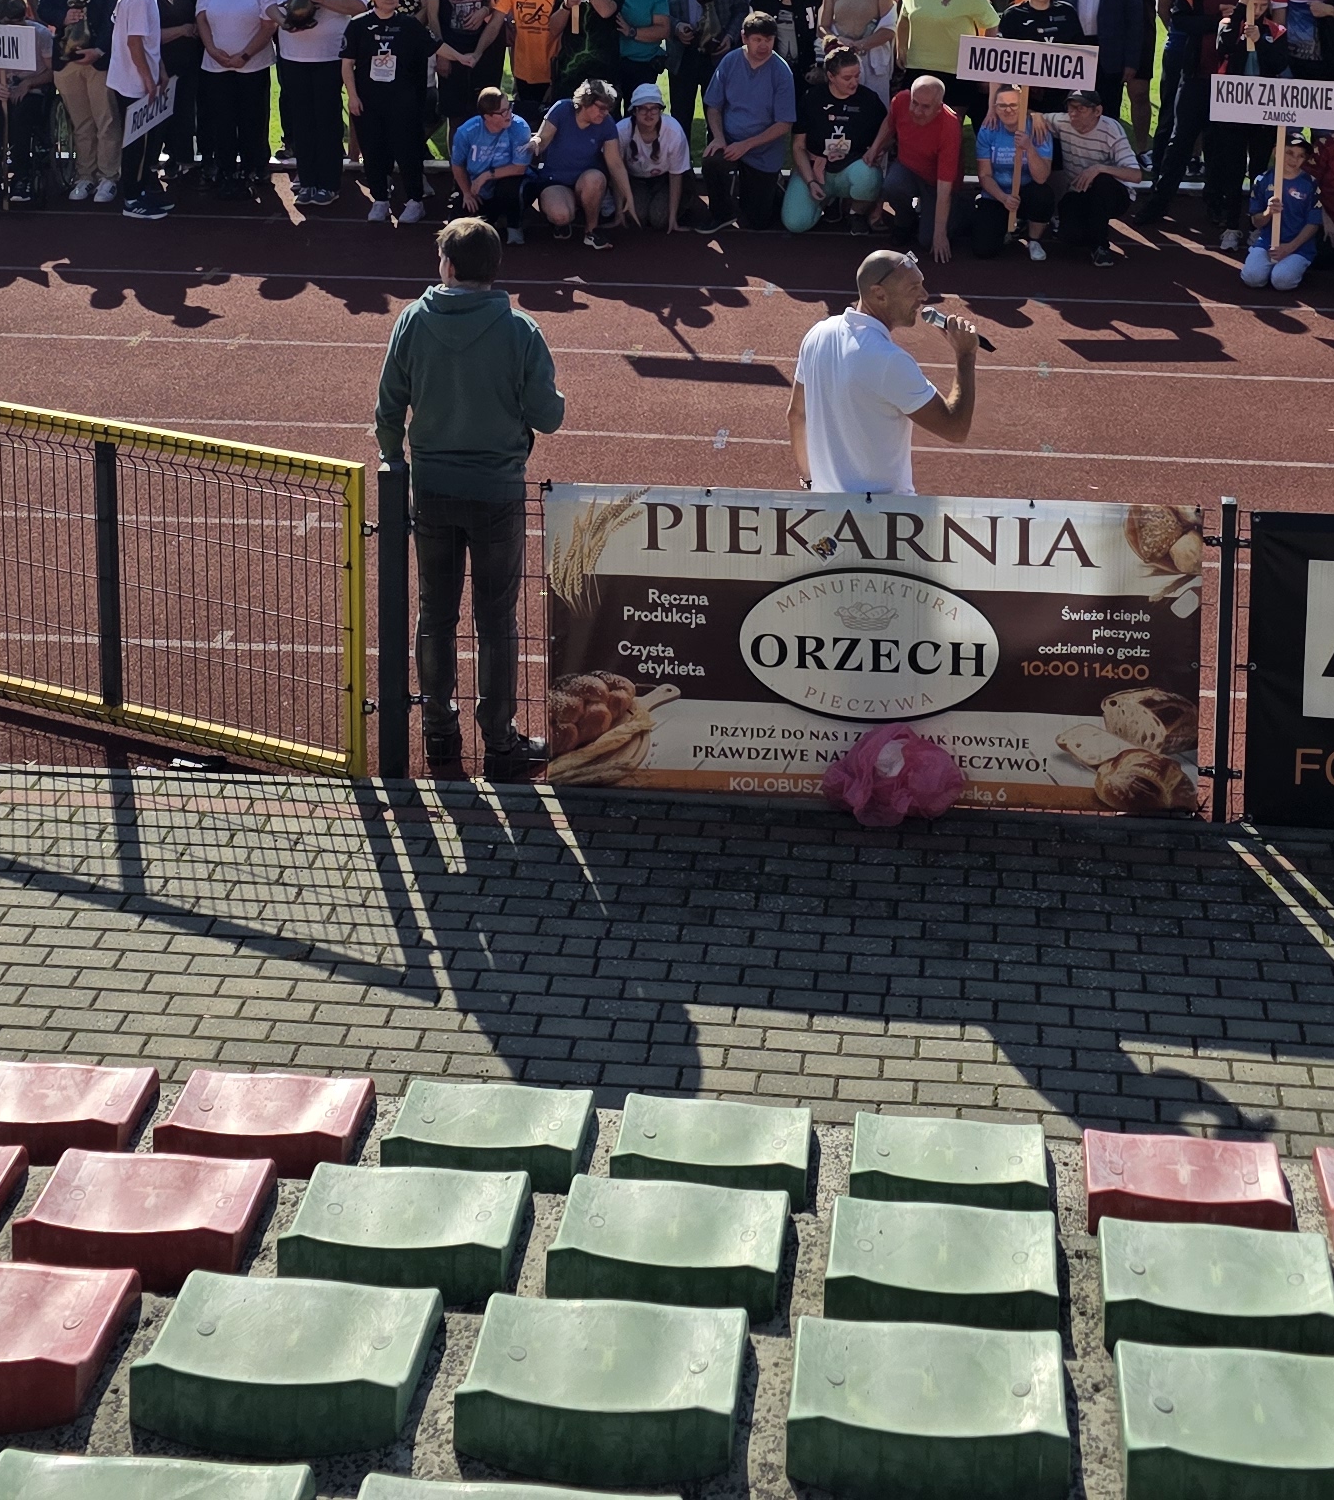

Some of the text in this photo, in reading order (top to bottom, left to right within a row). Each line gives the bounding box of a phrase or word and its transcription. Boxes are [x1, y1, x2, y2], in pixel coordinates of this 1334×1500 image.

[968, 47, 1085, 80] MOGIELNICA
[1215, 82, 1251, 106] KROK
[1257, 84, 1275, 108] ZA
[1262, 109, 1297, 124] ZAMOŚĆ
[641, 502, 1100, 569] PIEKARNIA
[648, 588, 709, 608] Ręczna
[776, 578, 960, 622] MANUFAKTURA
[623, 607, 707, 626] Produkcja
[1061, 607, 1101, 623] Świeże
[1112, 609, 1151, 626] ciepłe
[1092, 627, 1151, 643] pieczywo
[617, 641, 674, 661] Czysta
[750, 633, 987, 677] ORZECH
[1038, 643, 1102, 657] codziennie
[638, 659, 706, 677] etykieta
[1020, 660, 1150, 681] 10:00 i 14:00
[804, 685, 935, 714] PIECZYWA
[781, 728, 806, 741] DO
[809, 729, 839, 742] NAS
[692, 743, 809, 763] PRAWDZIWE
[951, 755, 1047, 773] ECZYWO!
[996, 787, 1007, 801] 6
